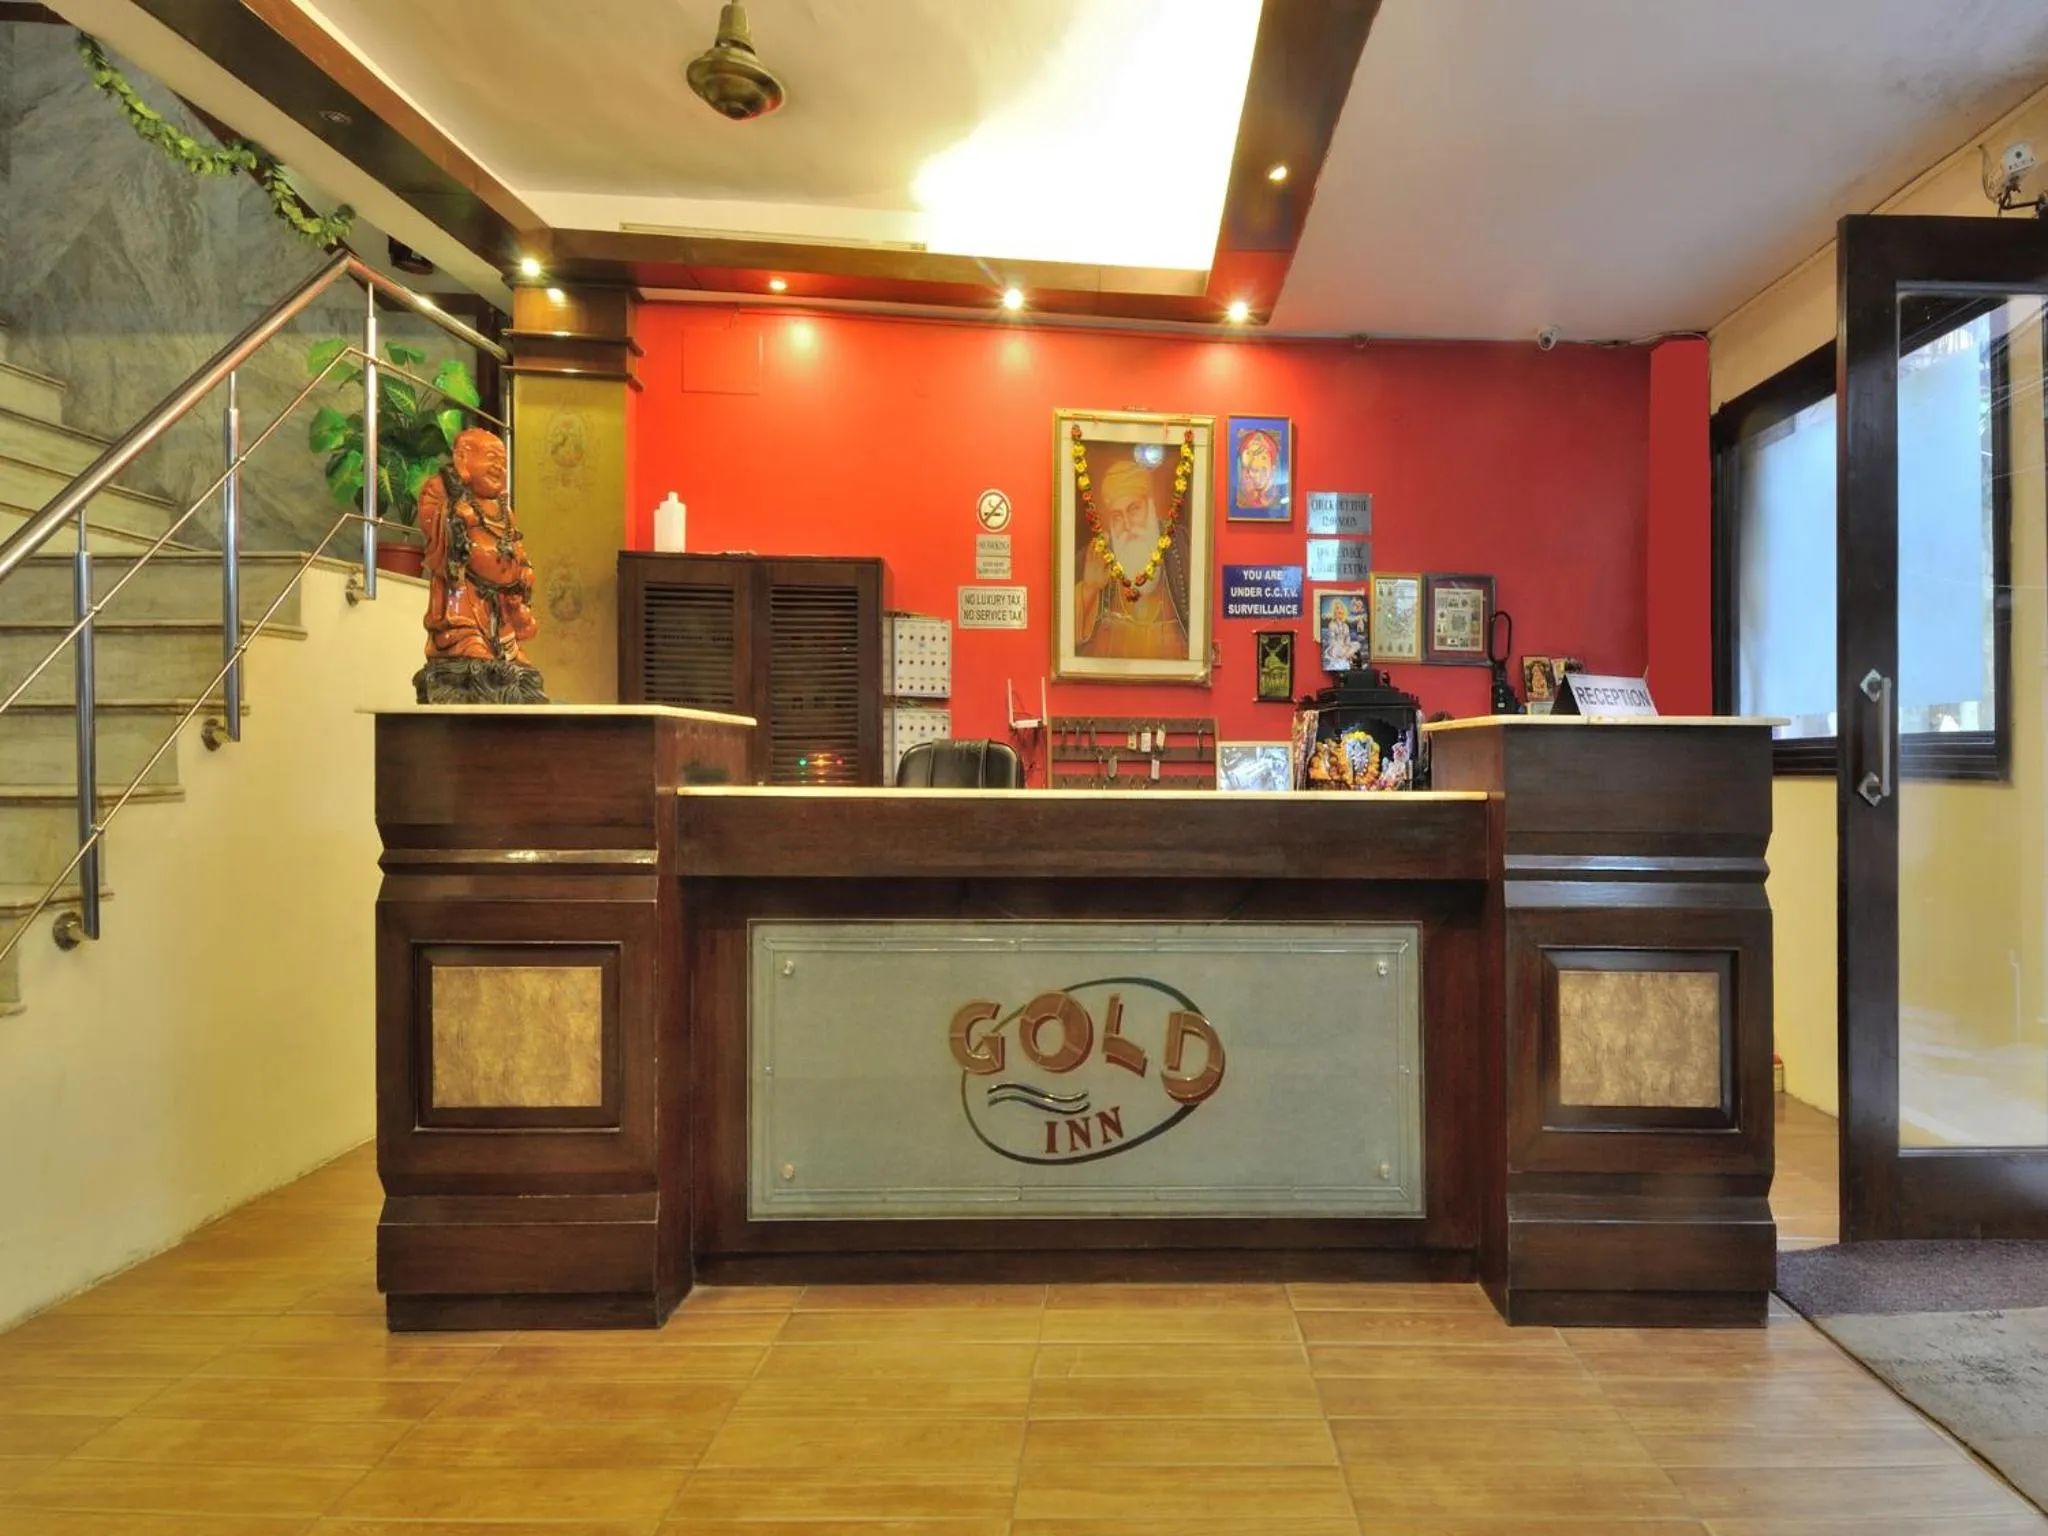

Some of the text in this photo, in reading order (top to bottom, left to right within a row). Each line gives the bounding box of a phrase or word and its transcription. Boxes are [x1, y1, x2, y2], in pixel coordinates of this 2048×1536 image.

[1243, 569, 1284, 581] YOU ARE
[1230, 587, 1263, 598] UNDER
[965, 594, 1021, 606] NO LUXURY TAX
[963, 609, 1023, 621] NO SERVICE TAX
[1228, 604, 1298, 615] SURVEILLANCE
[1575, 686, 1651, 707] RECEPTION
[949, 990, 1226, 1105] GOLD
[1045, 1106, 1124, 1154] INN
